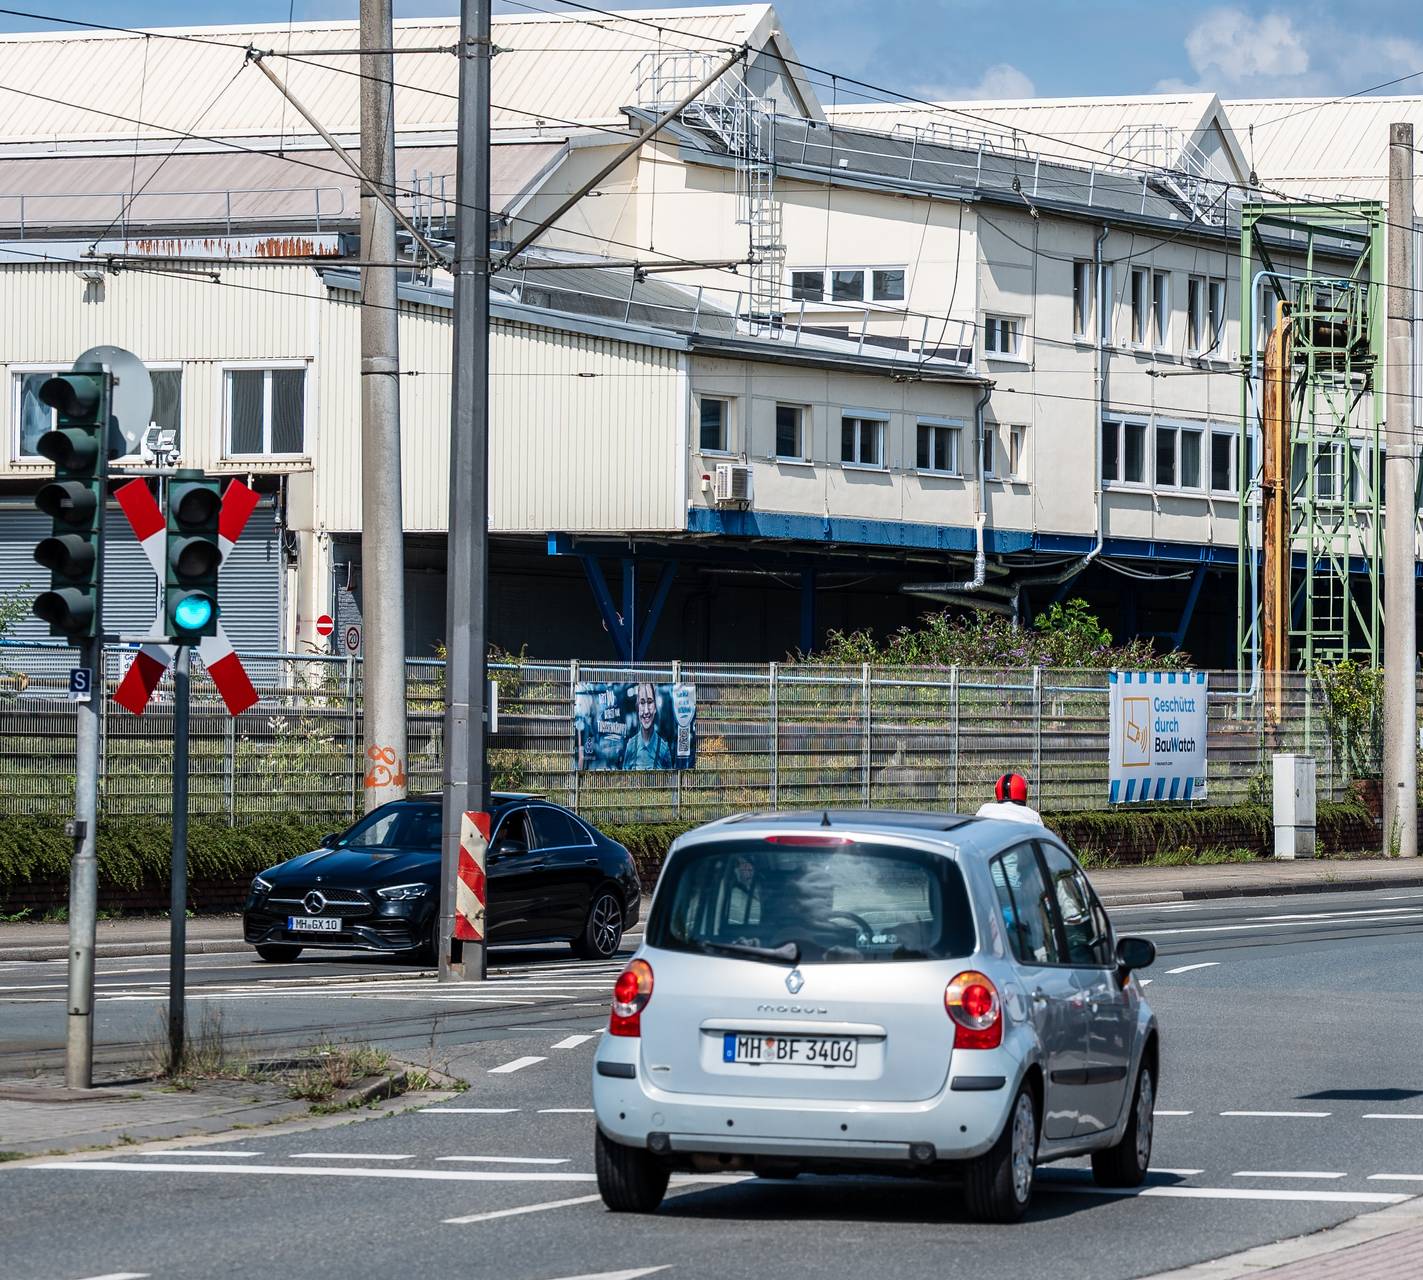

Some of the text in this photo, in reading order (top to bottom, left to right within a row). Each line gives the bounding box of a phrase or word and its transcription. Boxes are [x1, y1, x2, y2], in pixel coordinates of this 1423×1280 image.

[74, 671, 87, 690] S
[1154, 696, 1196, 713] Geschützt
[1155, 716, 1179, 733] durch
[1155, 737, 1196, 752] BauWatch
[312, 919, 324, 930] GX
[325, 920, 337, 930] 10
[737, 1037, 761, 1059] MH
[776, 1039, 800, 1060] BF
[806, 1041, 853, 1063] 3406
